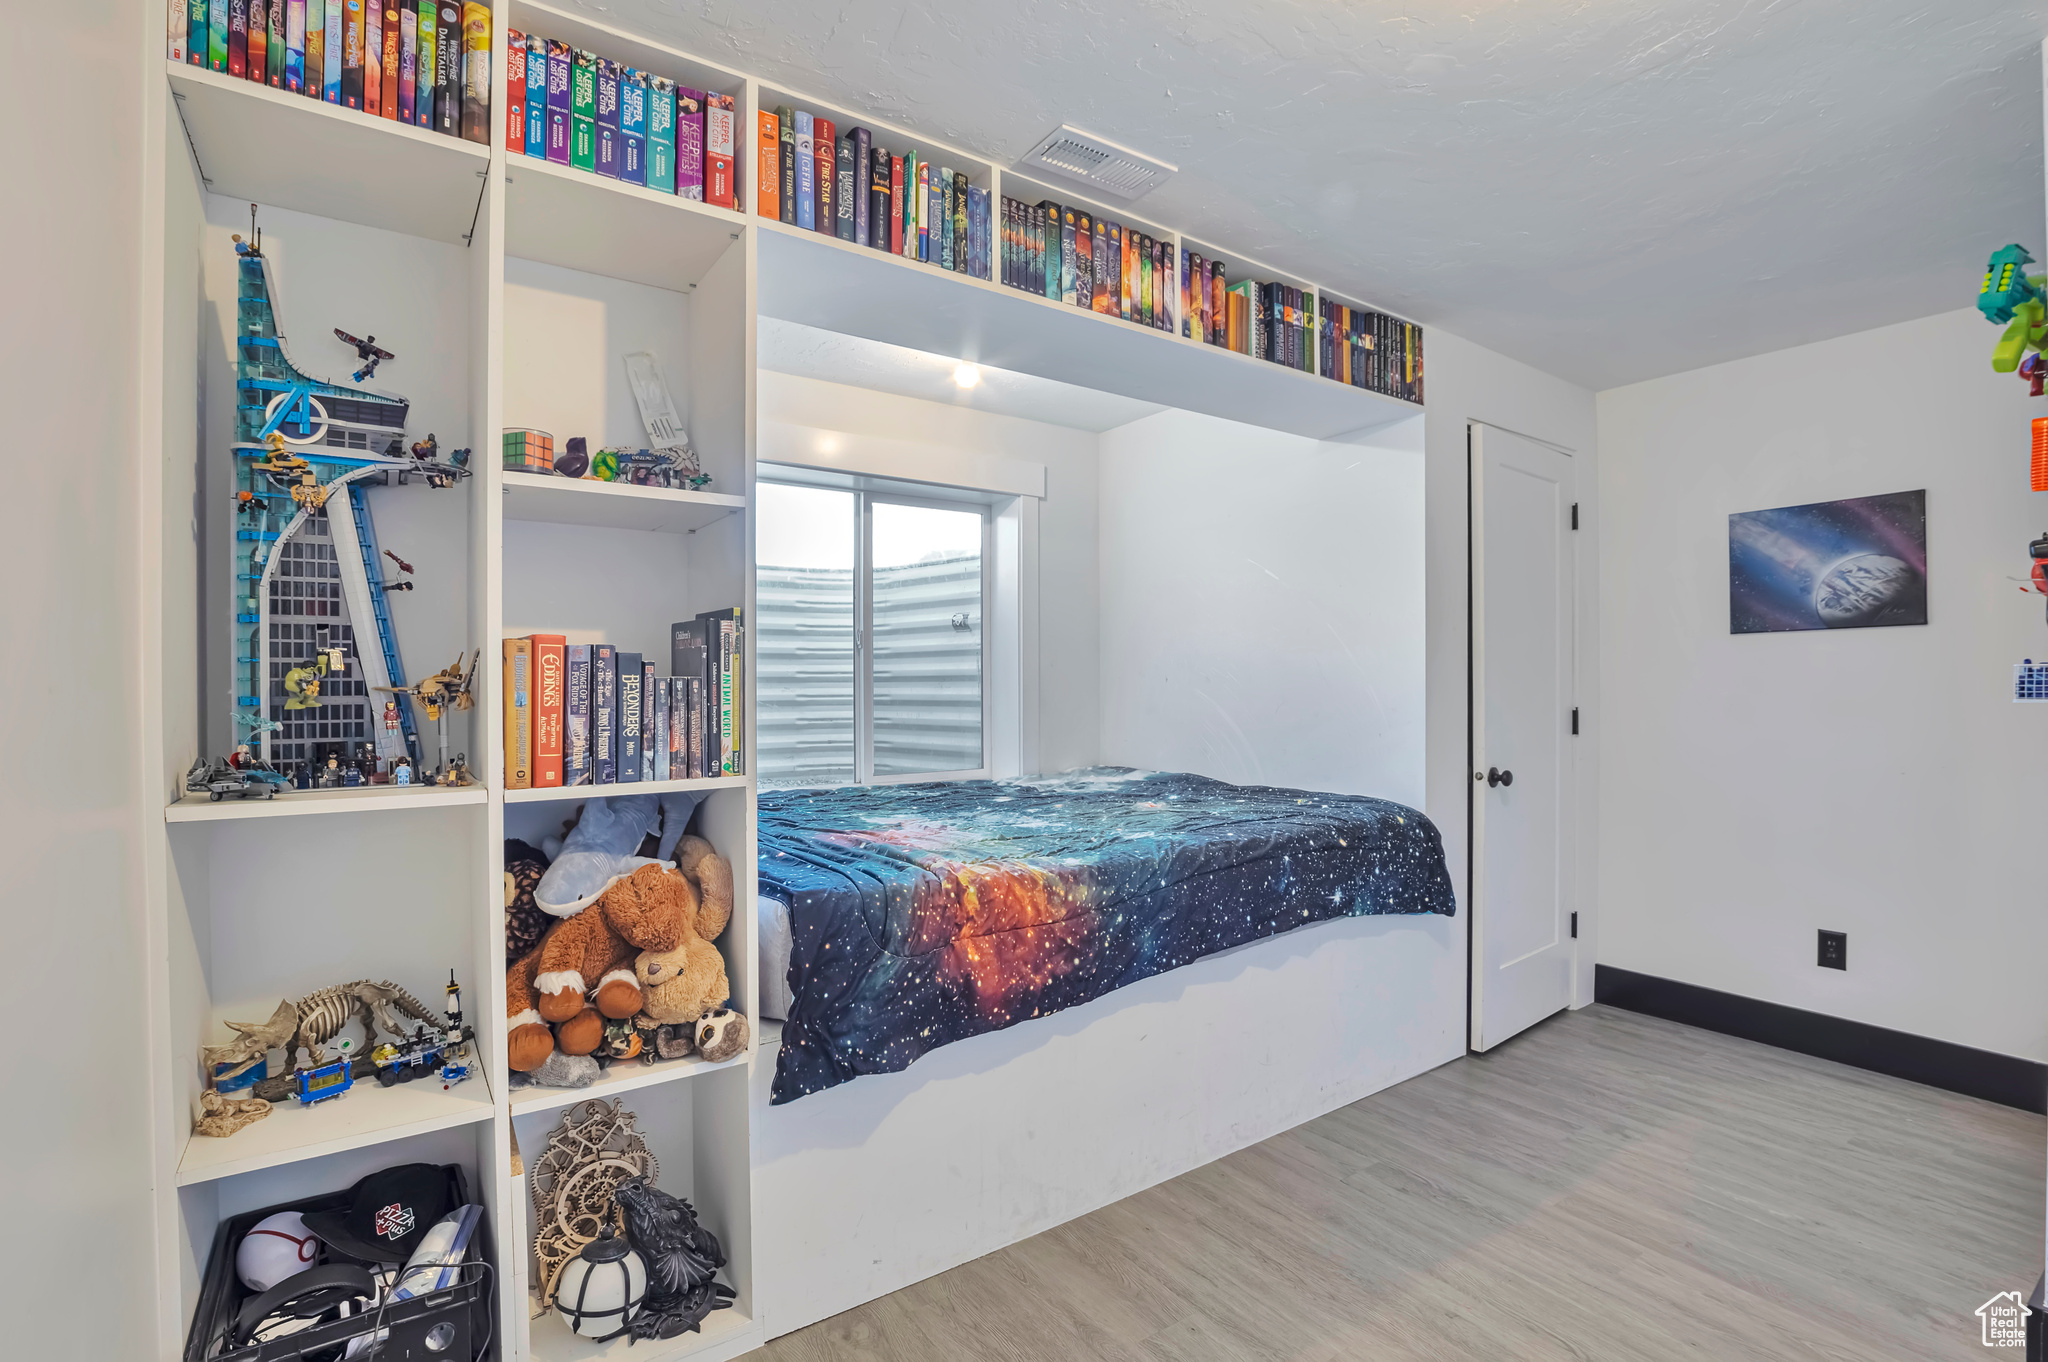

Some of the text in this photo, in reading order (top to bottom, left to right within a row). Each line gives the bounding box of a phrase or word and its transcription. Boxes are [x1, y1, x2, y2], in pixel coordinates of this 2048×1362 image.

[438, 28, 448, 86] DARKSTALKER
[514, 52, 524, 82] KEEPER
[534, 58, 546, 90] KEEPER
[556, 62, 568, 96] KEEPER
[582, 72, 592, 108] KEEPER
[606, 80, 616, 116] KEEPER
[631, 89, 643, 127] KEEPER
[660, 97, 670, 133] KEEPER
[689, 122, 700, 170] KEEPER
[719, 114, 730, 149] KEEPER
[802, 156, 810, 193] ICEFIRE
[821, 162, 831, 180] FIRE
[821, 180, 831, 203] STAR
[838, 171, 854, 221] VAMPIRATES
[542, 653, 560, 706] EDDINGS
[571, 672, 580, 706] FOX RIDER
[580, 663, 588, 688] VOYAGE
[580, 690, 587, 698] OF
[622, 674, 640, 736] BEYONDERS
[722, 674, 731, 738] ANIMAL WORLD
[598, 708, 610, 726] DENNIS
[626, 742, 635, 756] MULL
[380, 1206, 414, 1226] PIZZA
